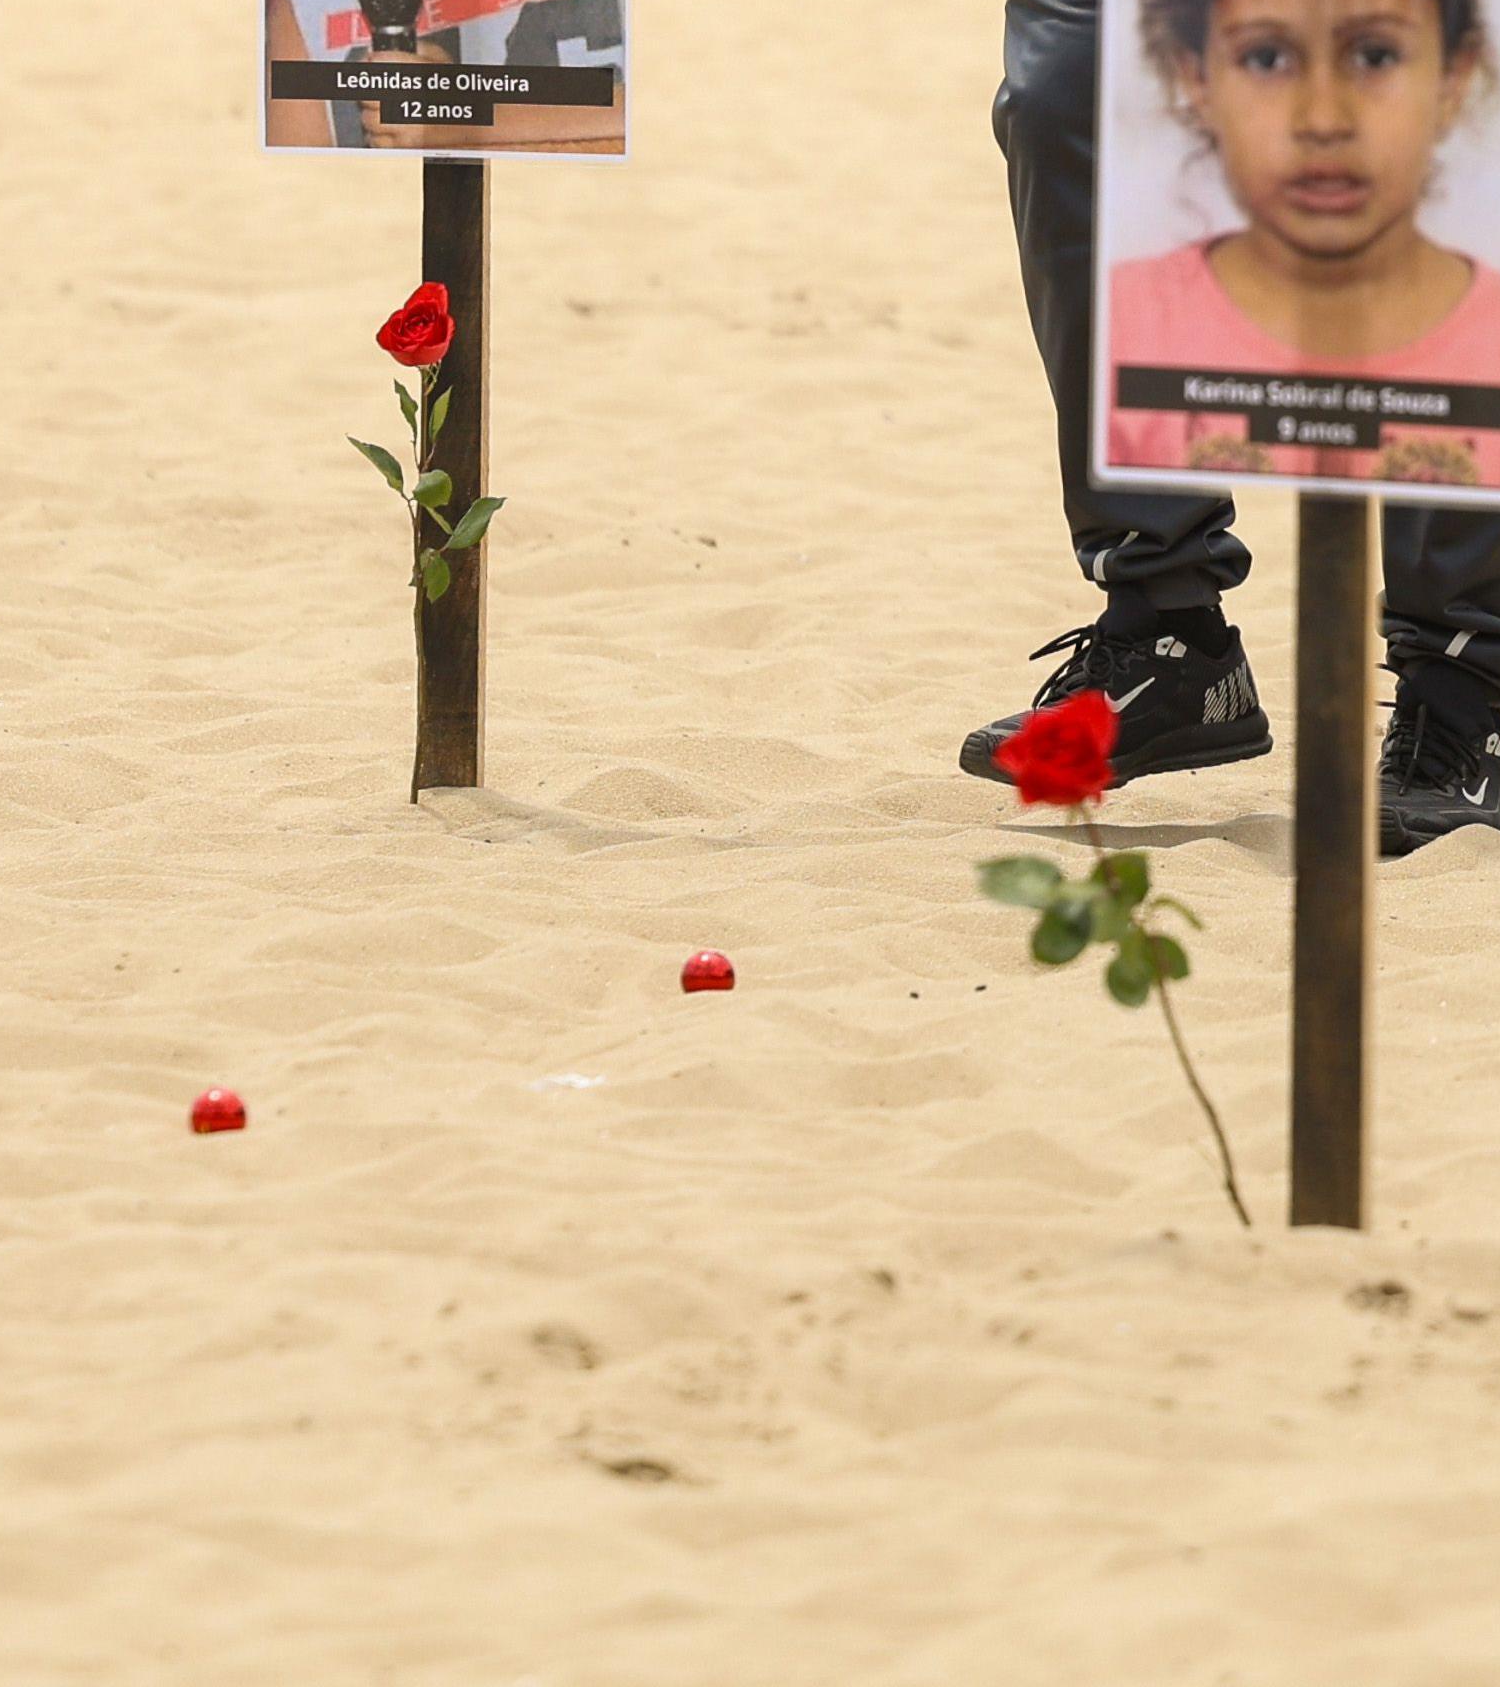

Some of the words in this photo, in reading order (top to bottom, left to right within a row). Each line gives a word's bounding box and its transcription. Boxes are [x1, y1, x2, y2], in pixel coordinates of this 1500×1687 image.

[336, 70, 422, 90] Leônidas
[427, 73, 451, 91] de
[456, 73, 530, 94] Oliveira
[400, 101, 422, 119] 12
[427, 104, 473, 120] anos
[1183, 376, 1264, 407] Karina
[1345, 385, 1378, 411] de
[1380, 387, 1450, 417] Souza
[1277, 417, 1295, 441] 9
[1298, 421, 1358, 445] anos
